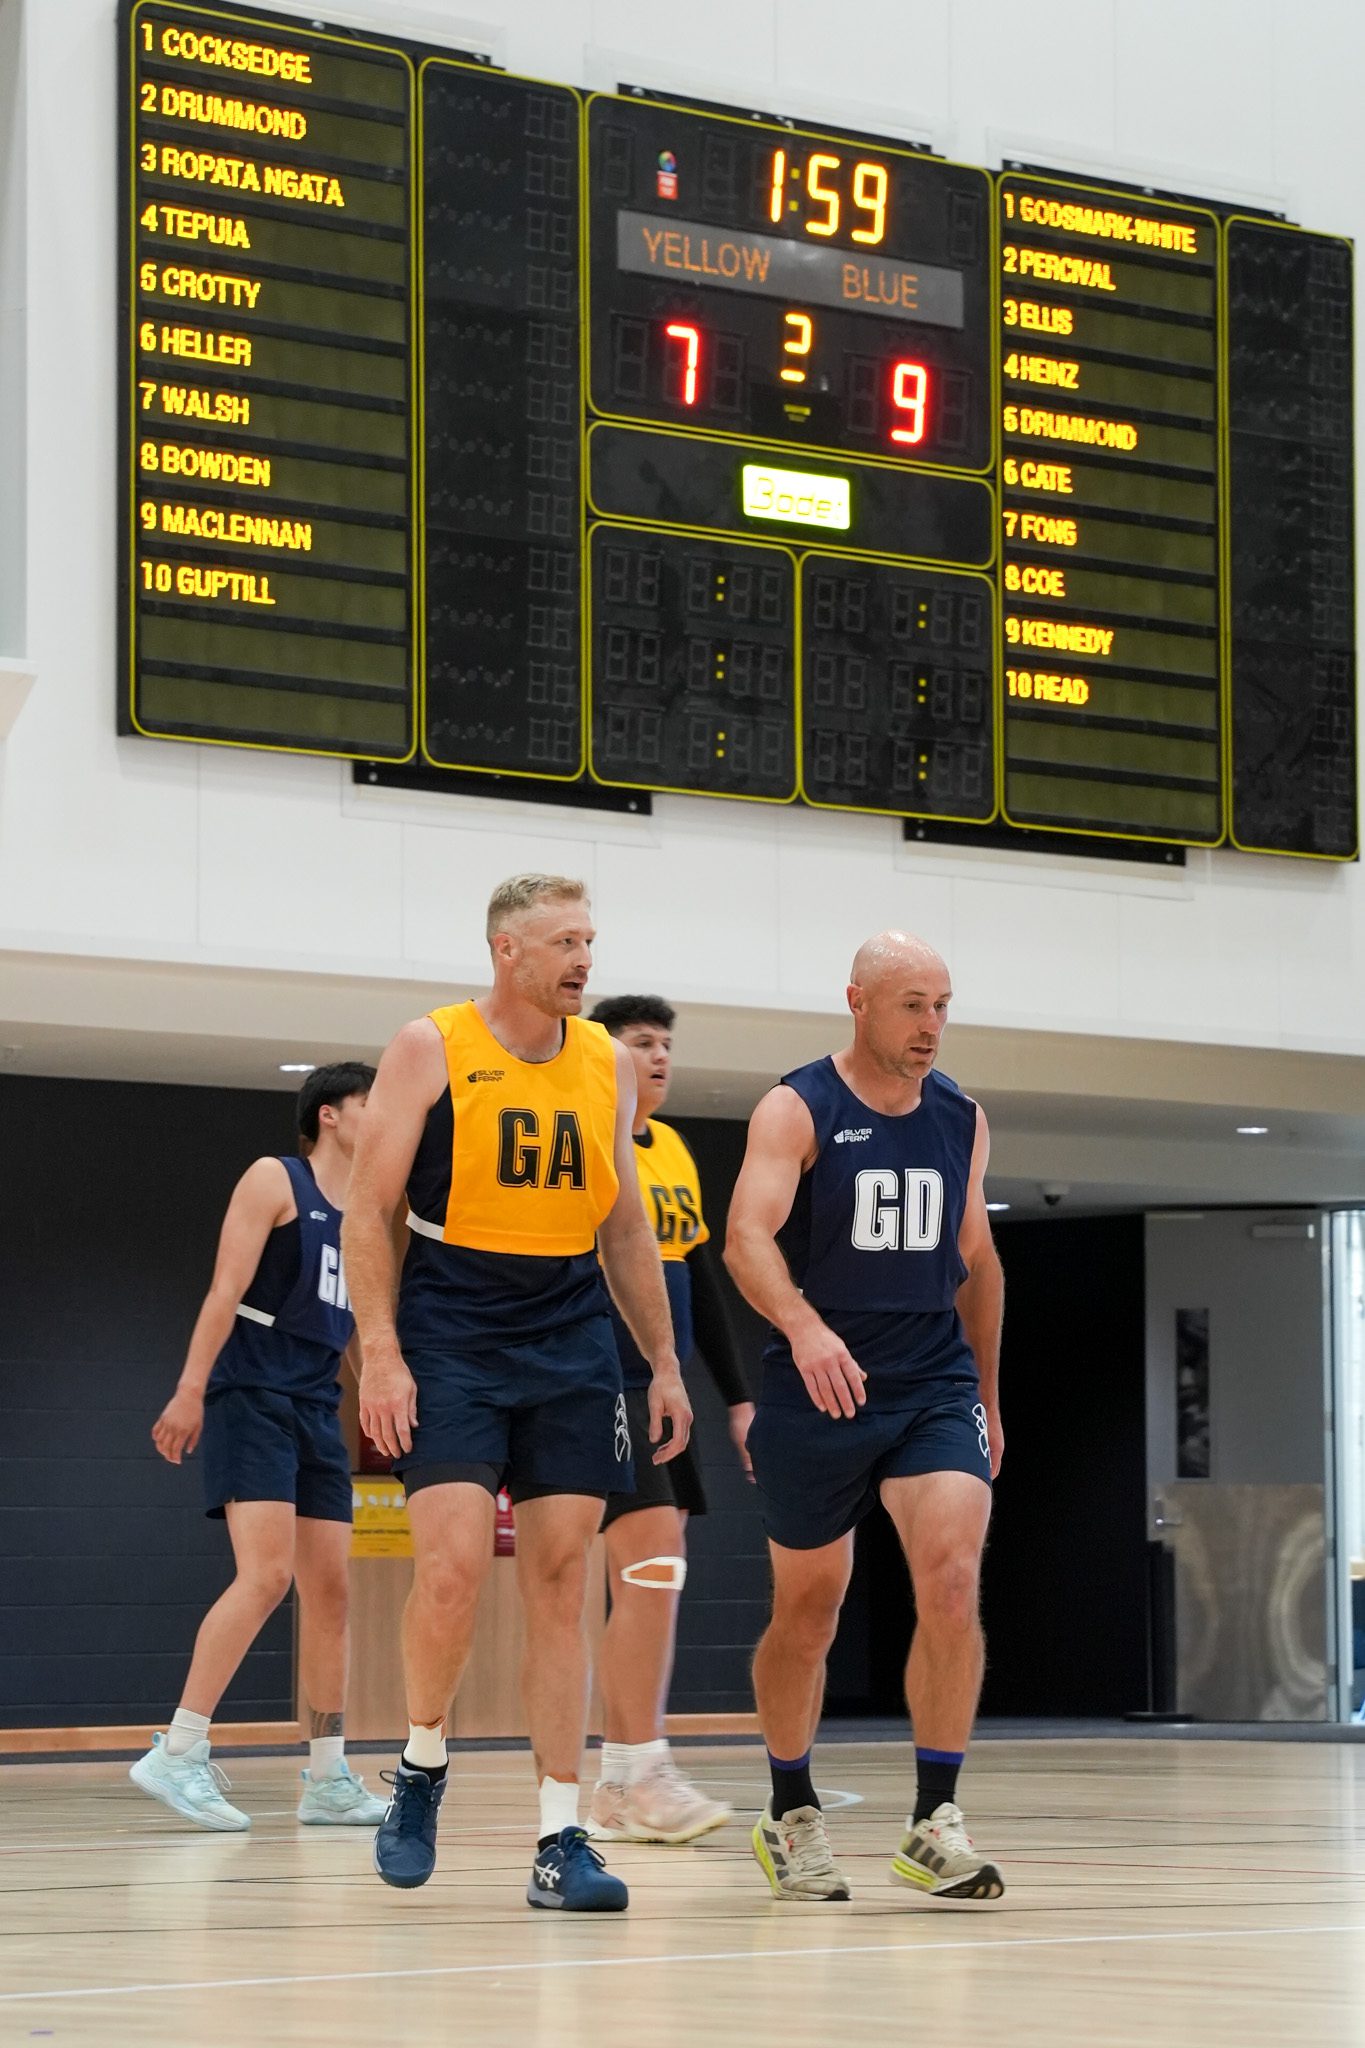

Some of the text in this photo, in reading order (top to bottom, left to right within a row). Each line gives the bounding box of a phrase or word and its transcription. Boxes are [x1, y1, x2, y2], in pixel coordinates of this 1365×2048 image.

[142, 24, 311, 83] 1 COCKSEDGE
[141, 84, 306, 139] 2 DRUMMOND
[141, 144, 344, 206] 3 ROPATA NGATA
[771, 151, 887, 244] 1:59
[141, 205, 250, 248] 4 TEPUIA
[1004, 194, 1196, 253] 1 GODSMARK-WHITE
[141, 264, 260, 308] 5 CROTTY
[643, 227, 917, 308] YELLOW BLUE
[1004, 247, 1116, 290] 2 PERCIVAL
[1003, 300, 1072, 334] 3 ELLIS
[141, 323, 251, 366] 6 HELLER
[667, 324, 699, 404] 7
[1004, 354, 1078, 388] 4 HEINZ
[140, 382, 249, 424] 7 WALSH
[891, 363, 928, 444] 9
[1004, 407, 1137, 449] 5 DRUMMOND
[141, 443, 270, 486] 8 BOWDEN
[1004, 459, 1072, 493] 6 CATE
[141, 503, 311, 550] 9 MACLENNAN
[1003, 512, 1077, 545] 7 FONG
[142, 562, 275, 604] 10 GUPTILL
[1005, 565, 1065, 596] 8 COE
[1005, 618, 1113, 654] 9 KENNEDY
[1006, 671, 1088, 704] 10 READ
[497, 1108, 586, 1190] GA
[844, 1128, 872, 1136] SILVER
[650, 1185, 700, 1244] GS
[851, 1168, 943, 1251] GD
